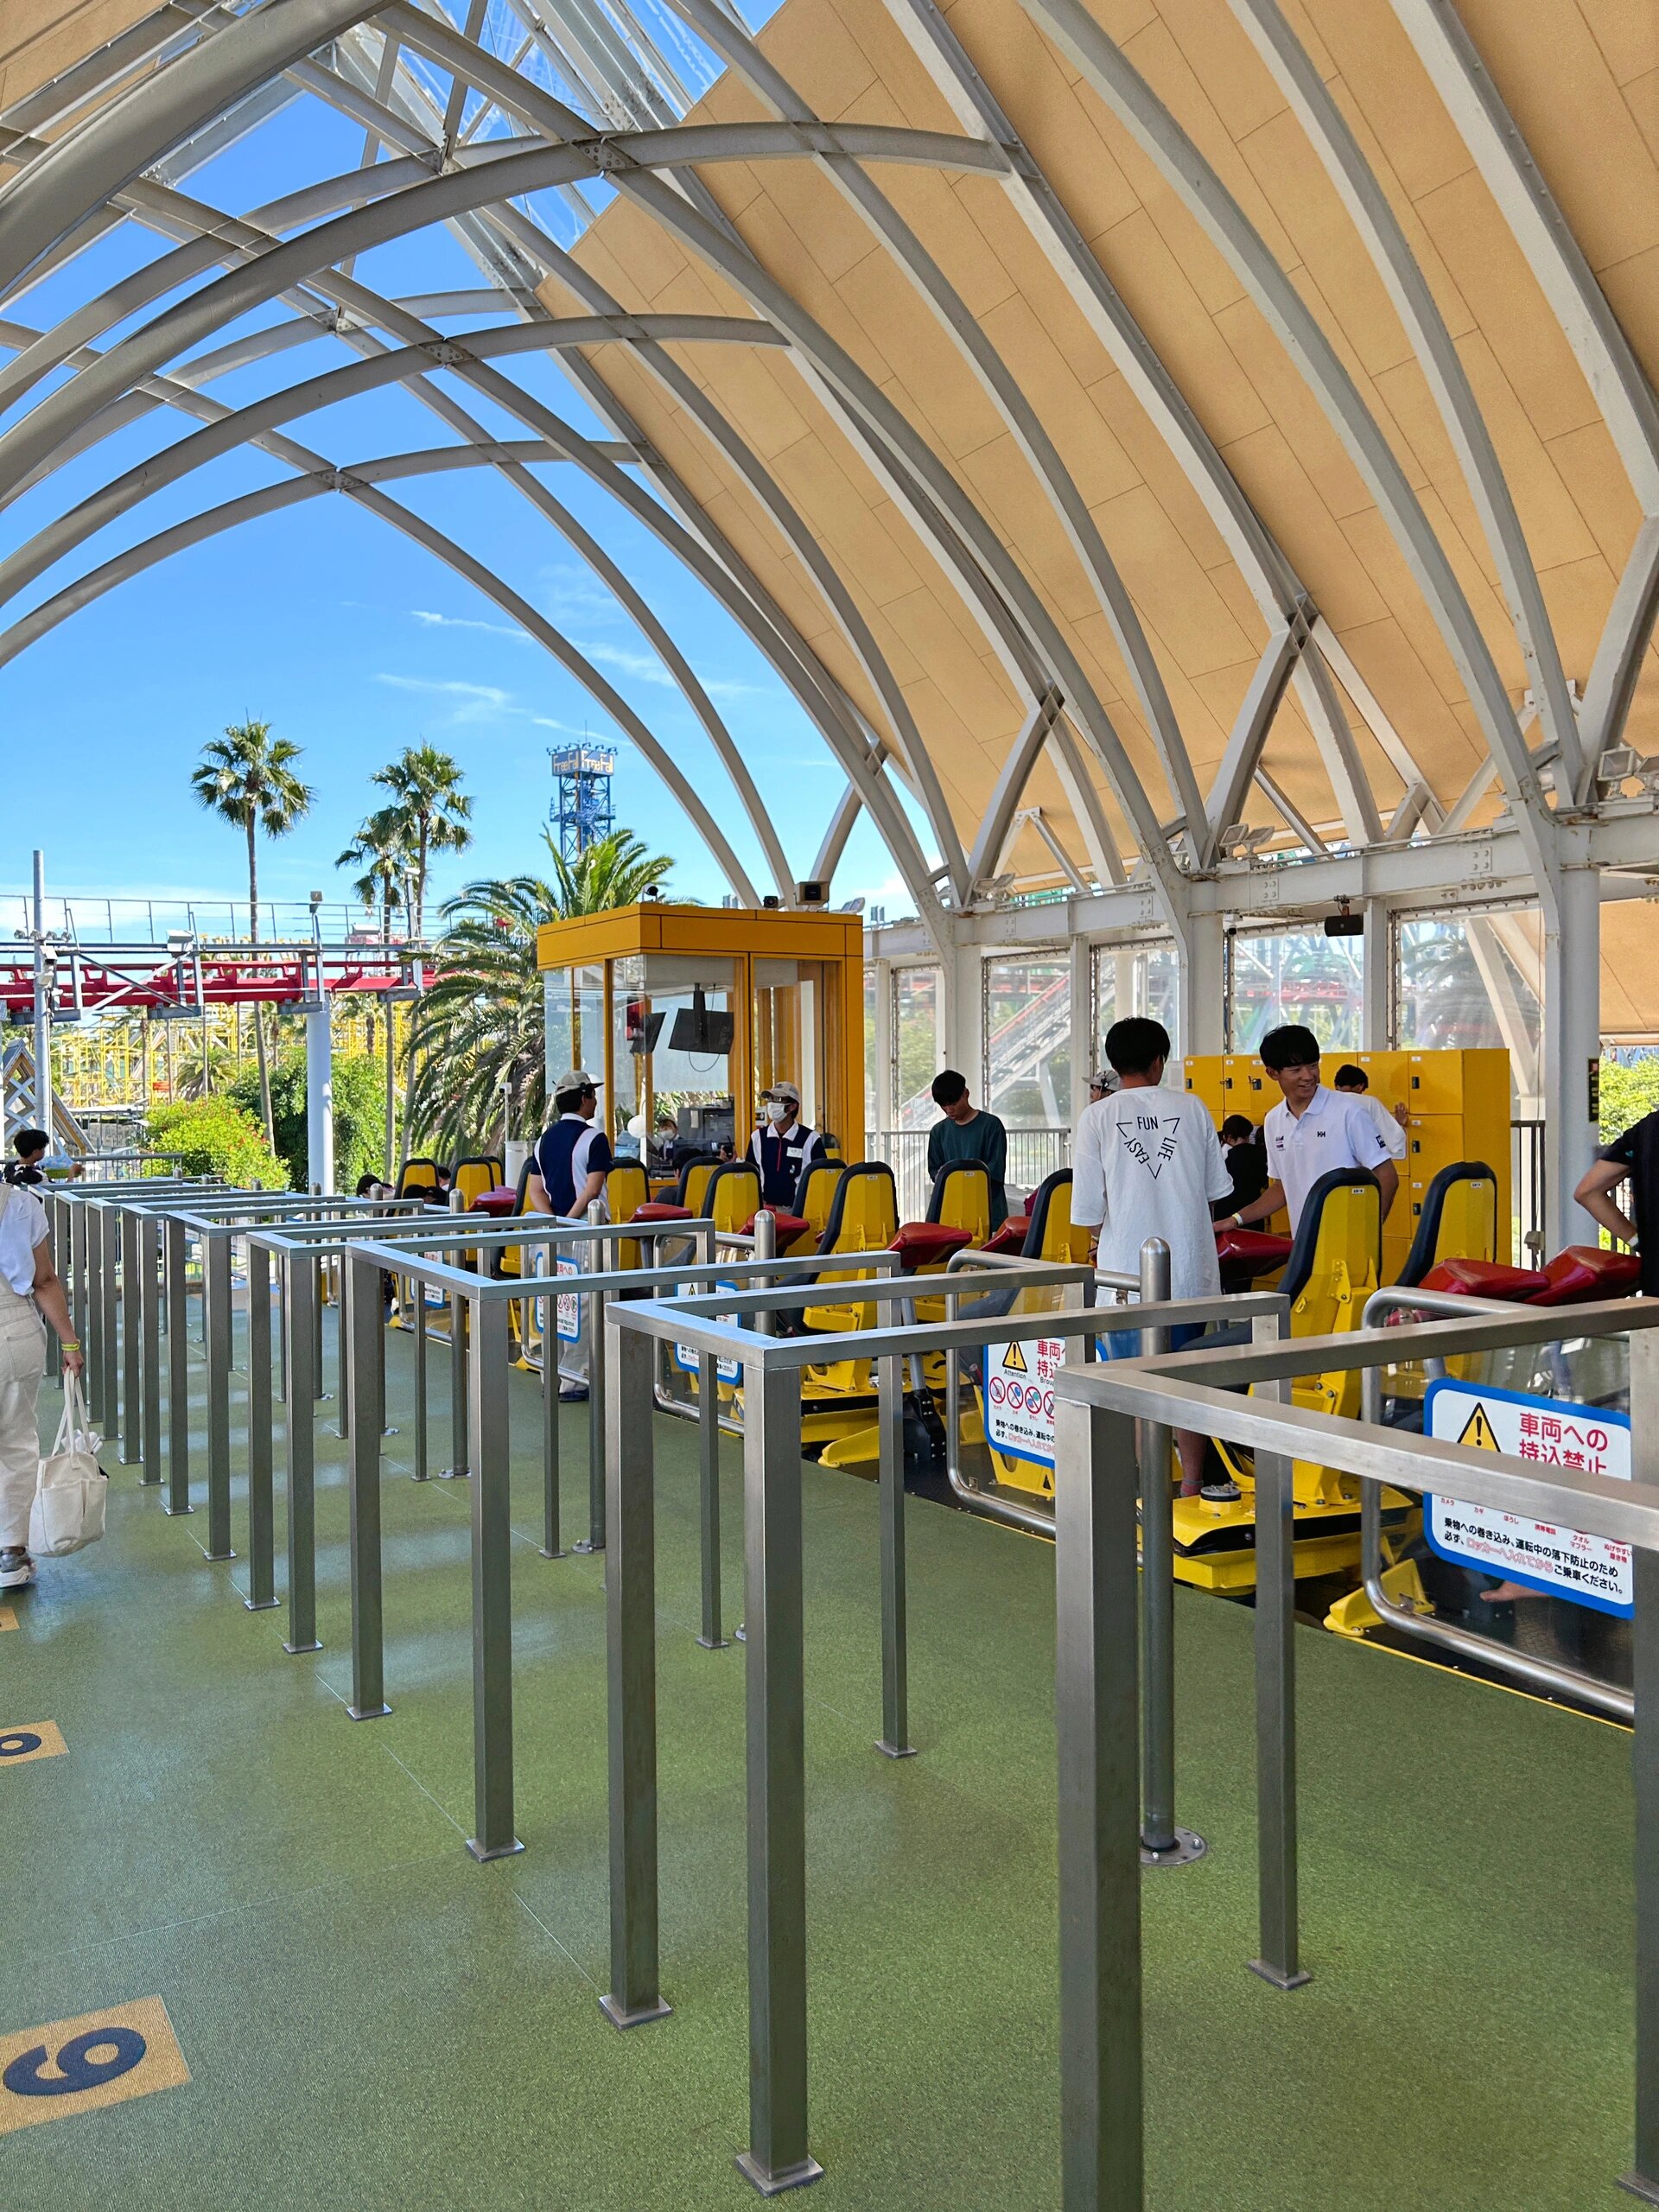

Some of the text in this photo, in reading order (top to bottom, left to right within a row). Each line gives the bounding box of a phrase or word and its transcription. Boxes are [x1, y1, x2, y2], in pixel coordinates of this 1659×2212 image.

[1136, 1116, 1159, 1130] FUN
[1123, 1137, 1150, 1164] EASY
[1157, 1136, 1178, 1161] LIFE
[1003, 1369, 1027, 1380] Attention
[1519, 1413, 1608, 1452] 車両への
[1444, 1517, 1618, 1578] 乗物への巻き込み、運転中の落下防止のため
[1573, 1535, 1590, 1544] タオル
